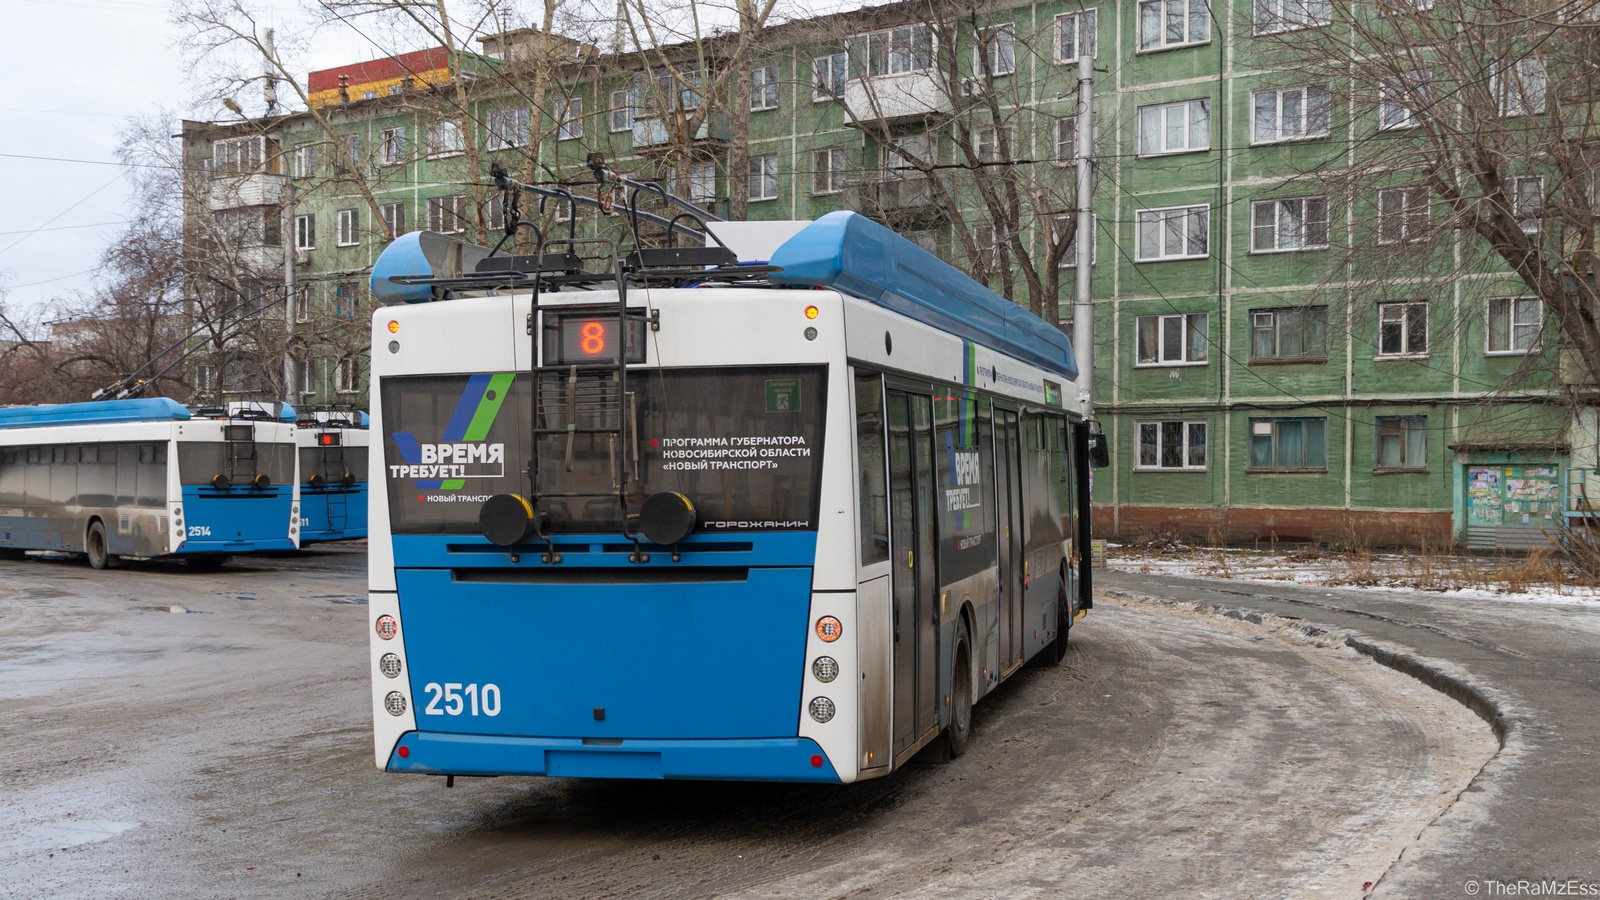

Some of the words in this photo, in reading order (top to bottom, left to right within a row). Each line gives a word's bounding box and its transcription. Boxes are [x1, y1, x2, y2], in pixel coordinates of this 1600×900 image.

[581, 321, 604, 355] 8
[662, 437, 728, 447] ПРОГРАММА
[730, 436, 806, 446] ГУБЕРНАТОРА
[421, 443, 504, 464] ВРЕМЯ
[662, 447, 757, 459] НОВОСИБИРСКОЙ
[759, 447, 811, 457] ОБЛАСТИ
[662, 459, 708, 470] «НОВЫЙ
[709, 460, 778, 470] ТРАНСПОРТ»
[955, 452, 979, 486] ВРЕМЯ
[390, 464, 466, 478] ТРЕБУЕТ!
[427, 494, 456, 502] НОВЫЙ
[704, 520, 809, 528] ГОРОЖАНИН
[188, 526, 212, 537] 2514
[424, 682, 501, 717] 2510
